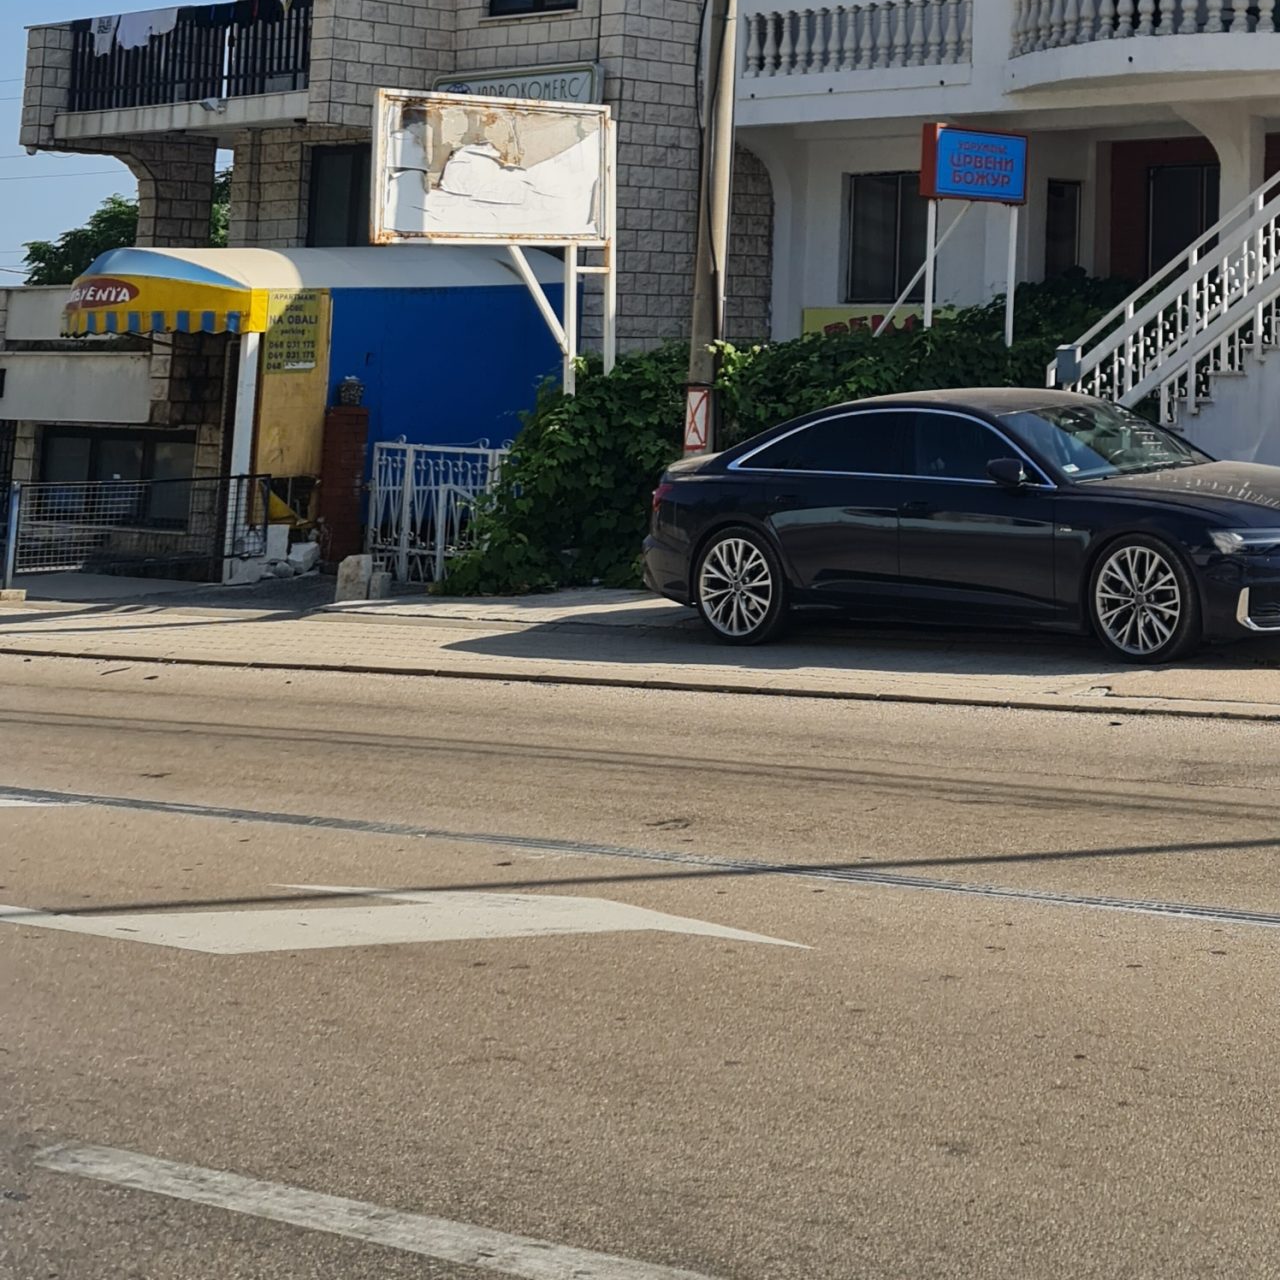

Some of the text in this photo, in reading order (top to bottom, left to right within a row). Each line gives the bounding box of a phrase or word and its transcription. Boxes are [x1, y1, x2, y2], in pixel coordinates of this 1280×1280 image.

[952, 154, 1014, 172] ЦРВЕНИ
[952, 171, 1010, 187] БОЖУР
[269, 314, 318, 324] NA OBALI
[280, 327, 305, 336] parking
